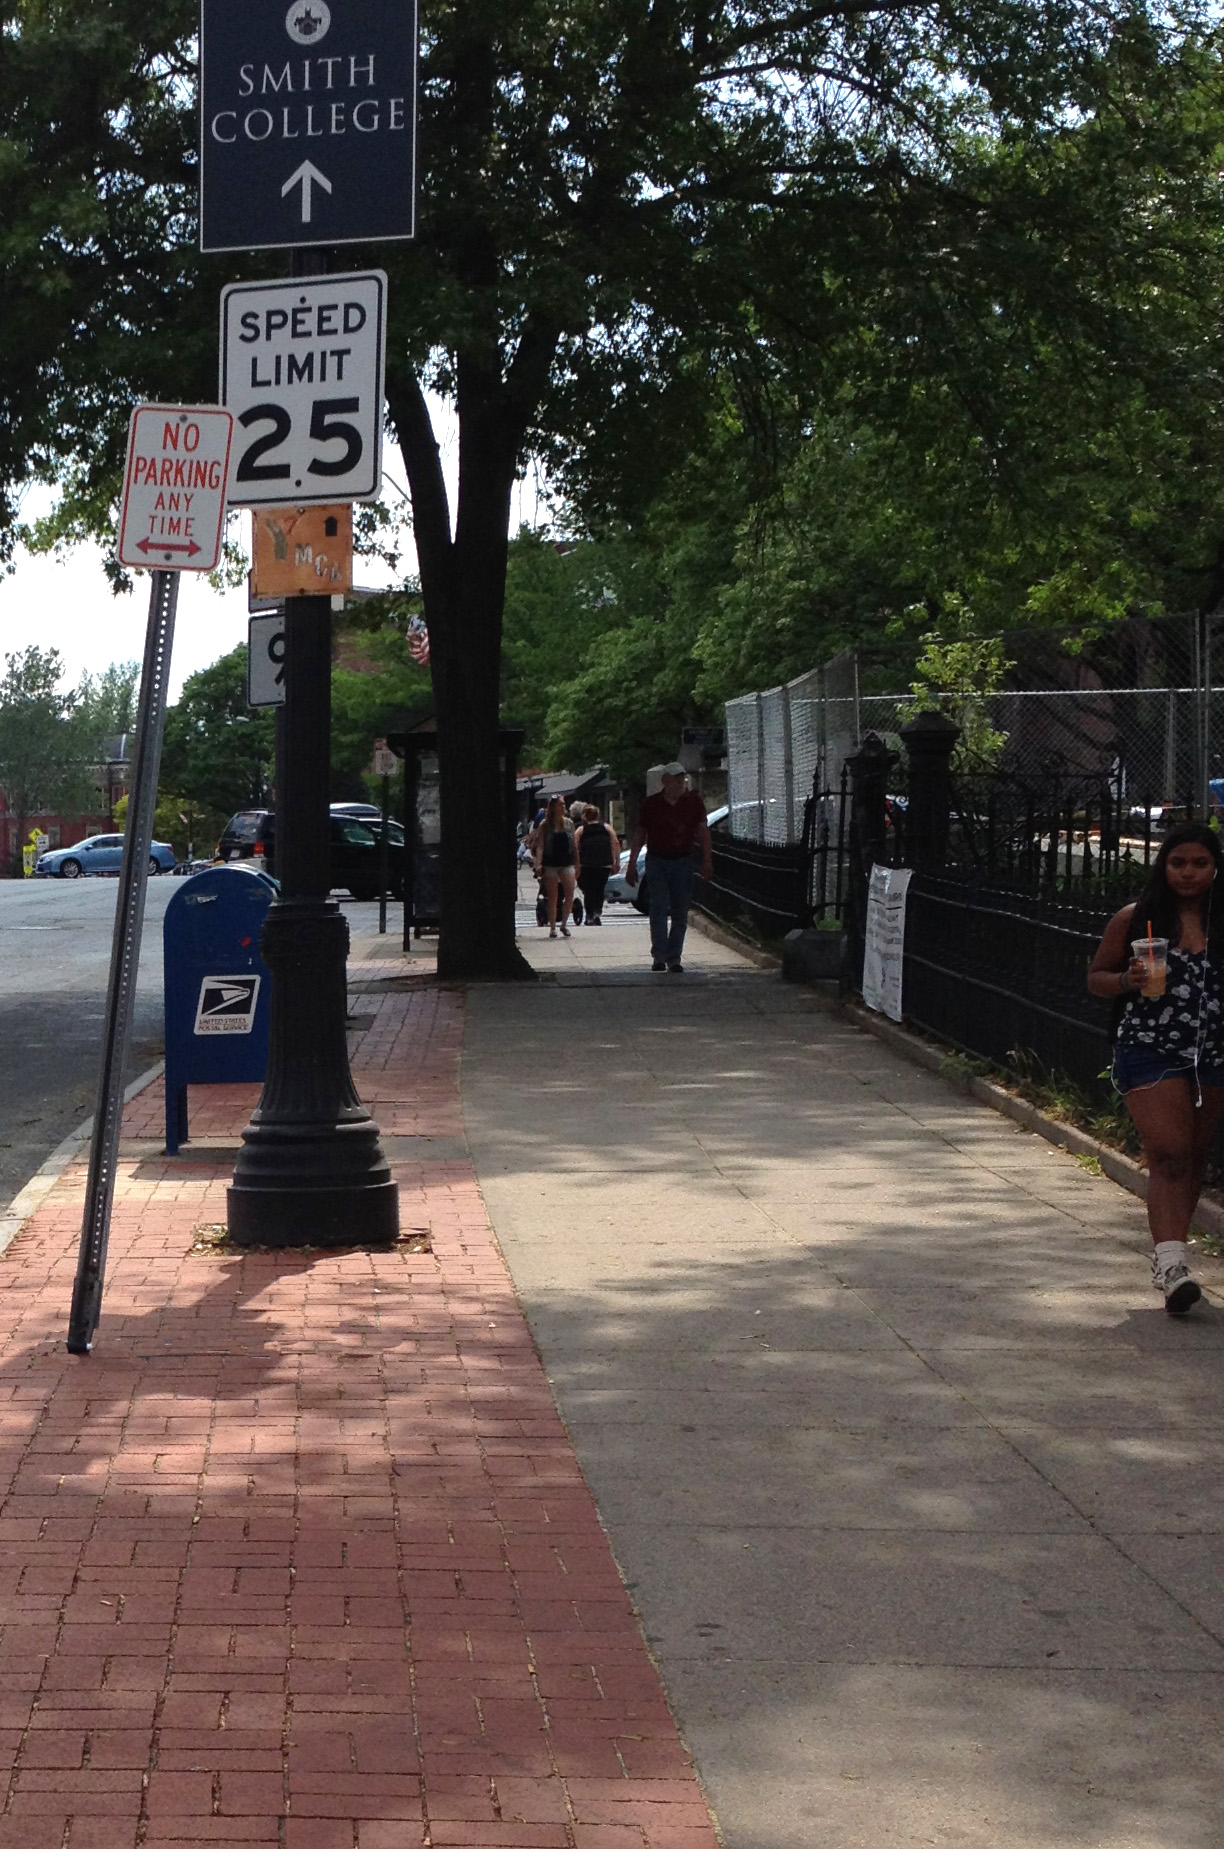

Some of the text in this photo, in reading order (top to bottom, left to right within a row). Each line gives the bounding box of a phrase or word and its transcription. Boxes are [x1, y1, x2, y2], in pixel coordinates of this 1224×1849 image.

[238, 54, 377, 97] SMITH
[211, 98, 405, 144] COLLEGE
[238, 302, 367, 344] SPEED
[250, 348, 352, 388] LIMIT
[162, 421, 200, 452] NO
[236, 397, 363, 483] 25
[133, 456, 222, 490] PARKING
[154, 492, 195, 513] ANY
[149, 515, 196, 537] TIME
